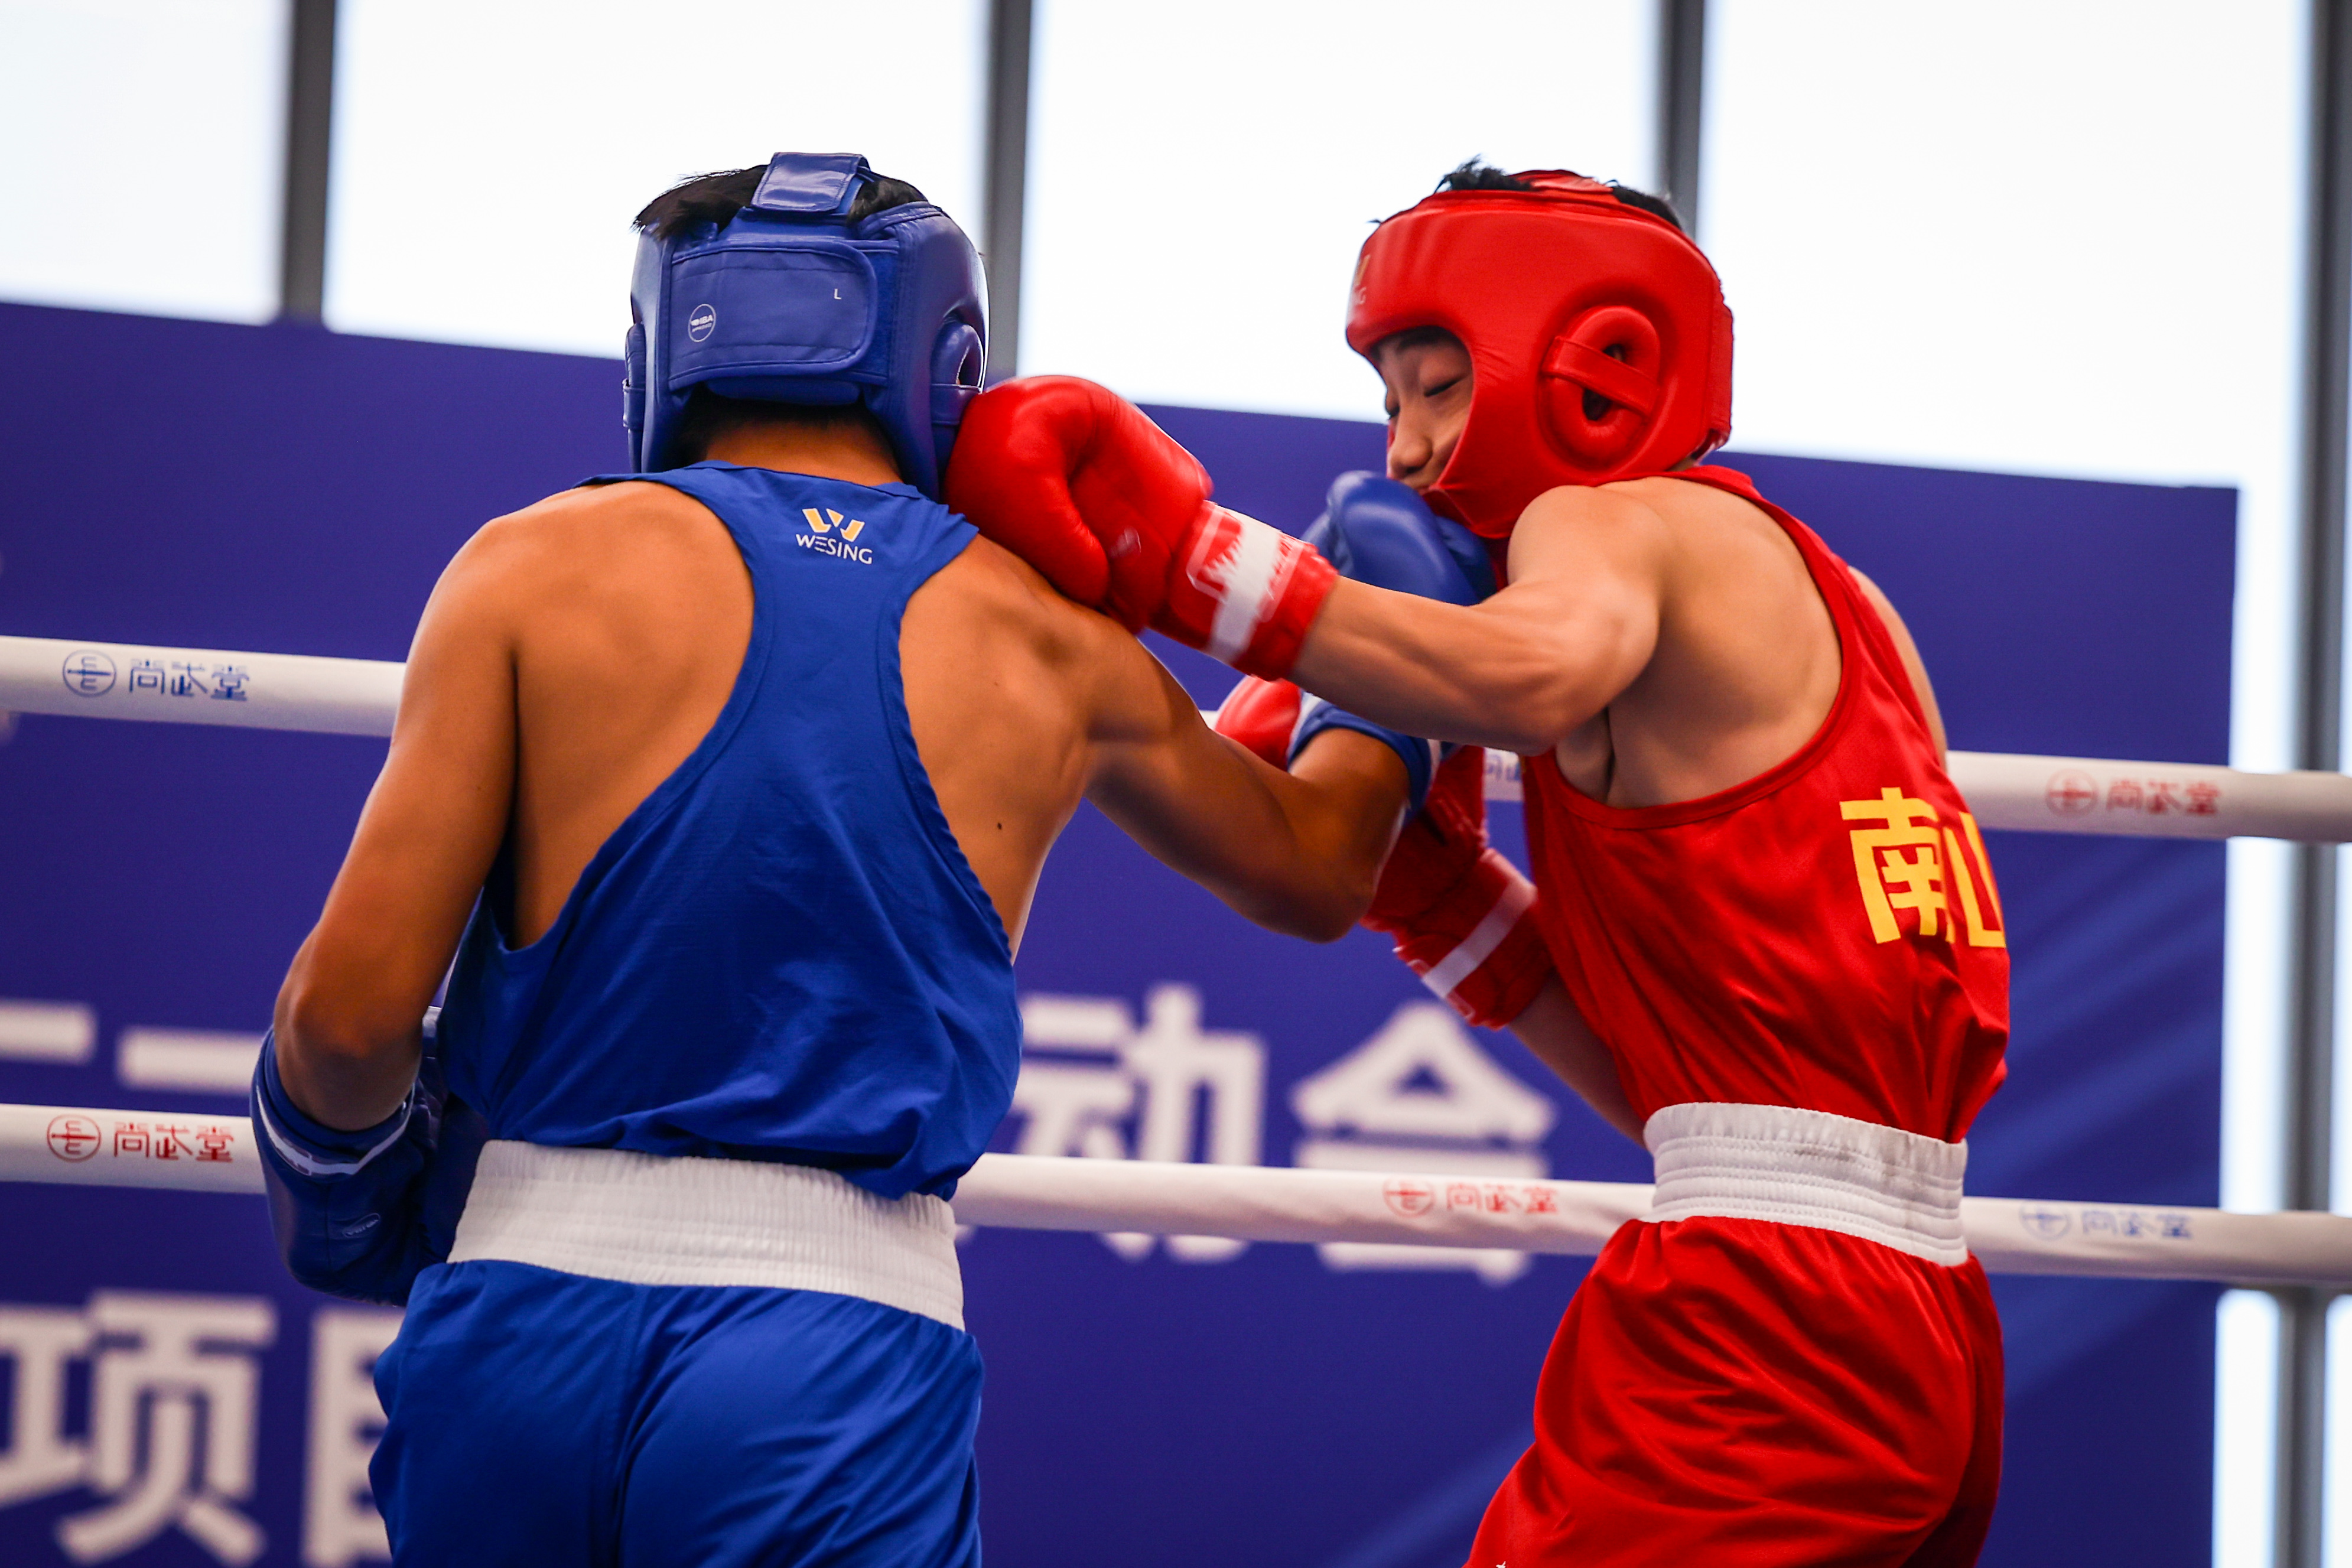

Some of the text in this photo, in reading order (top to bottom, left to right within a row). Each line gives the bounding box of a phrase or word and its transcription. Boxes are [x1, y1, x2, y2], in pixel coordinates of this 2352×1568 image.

[834, 288, 842, 300] L
[795, 533, 873, 565] WESING
[129, 652, 250, 702] 尚武堂
[113, 1121, 235, 1163] 尚武堂
